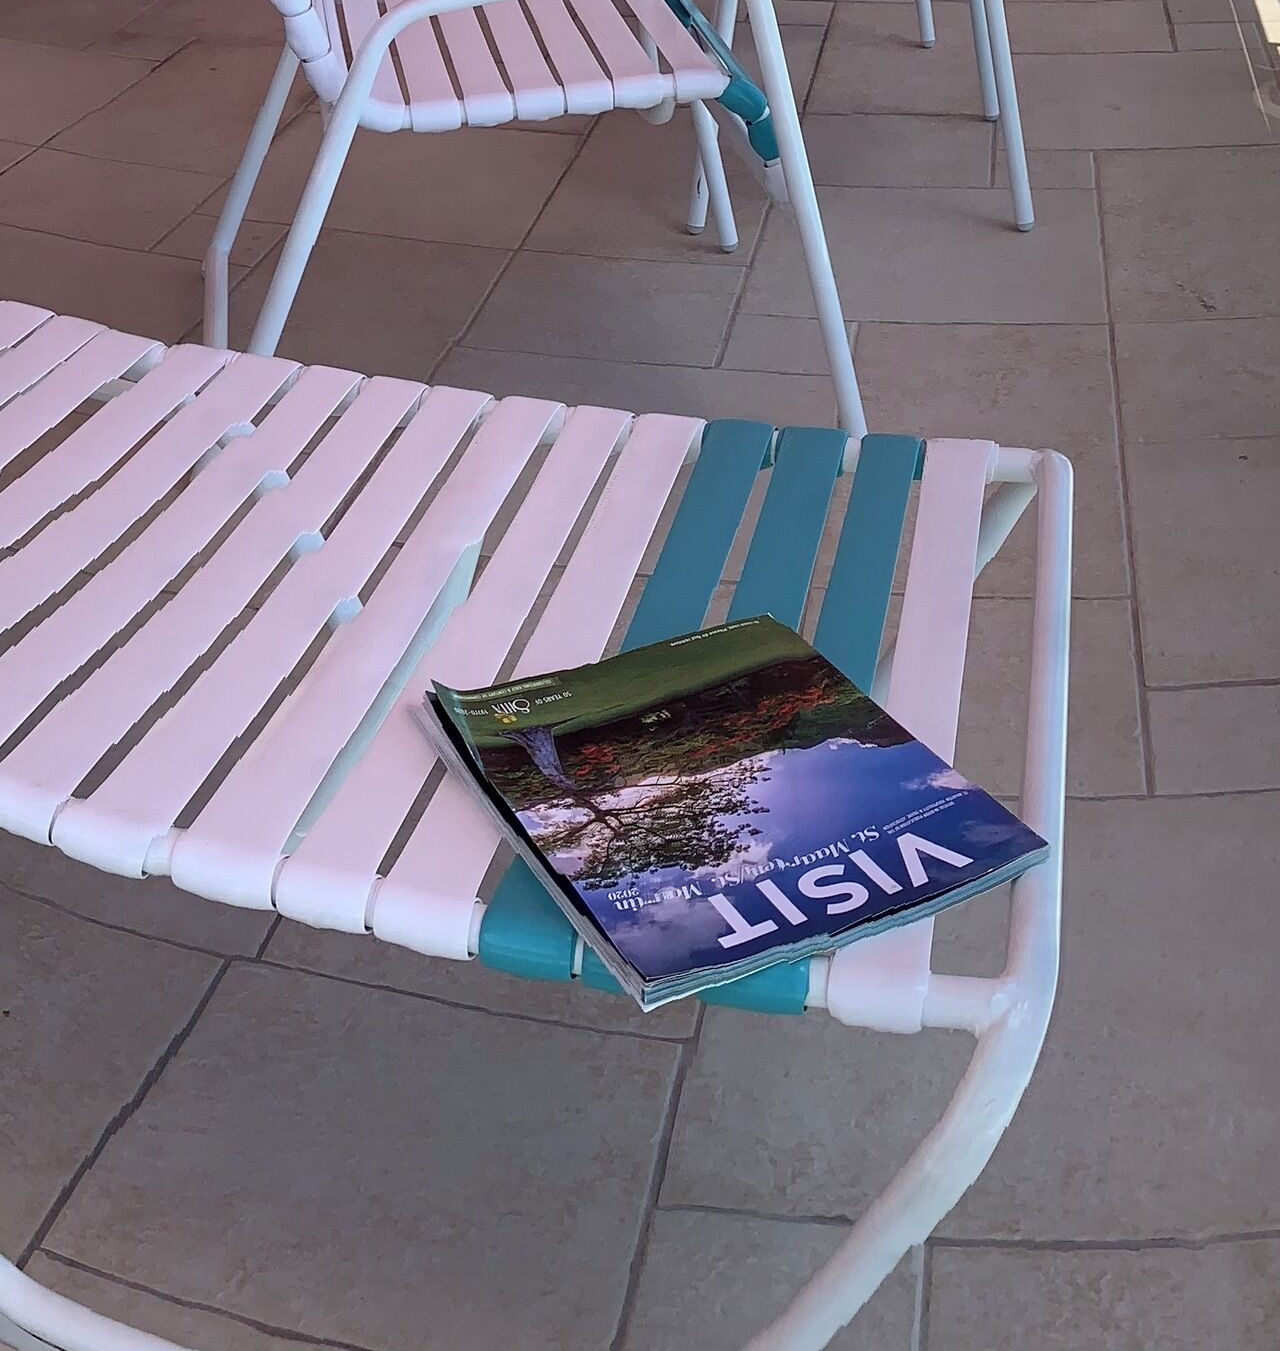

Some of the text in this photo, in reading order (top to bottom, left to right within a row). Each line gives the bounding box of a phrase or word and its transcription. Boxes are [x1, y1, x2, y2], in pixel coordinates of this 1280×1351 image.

[544, 693, 562, 704] YEARS
[562, 690, 572, 698] 50
[850, 825, 880, 843] St.
[606, 885, 639, 901] 2020
[708, 832, 974, 949] VISIT
